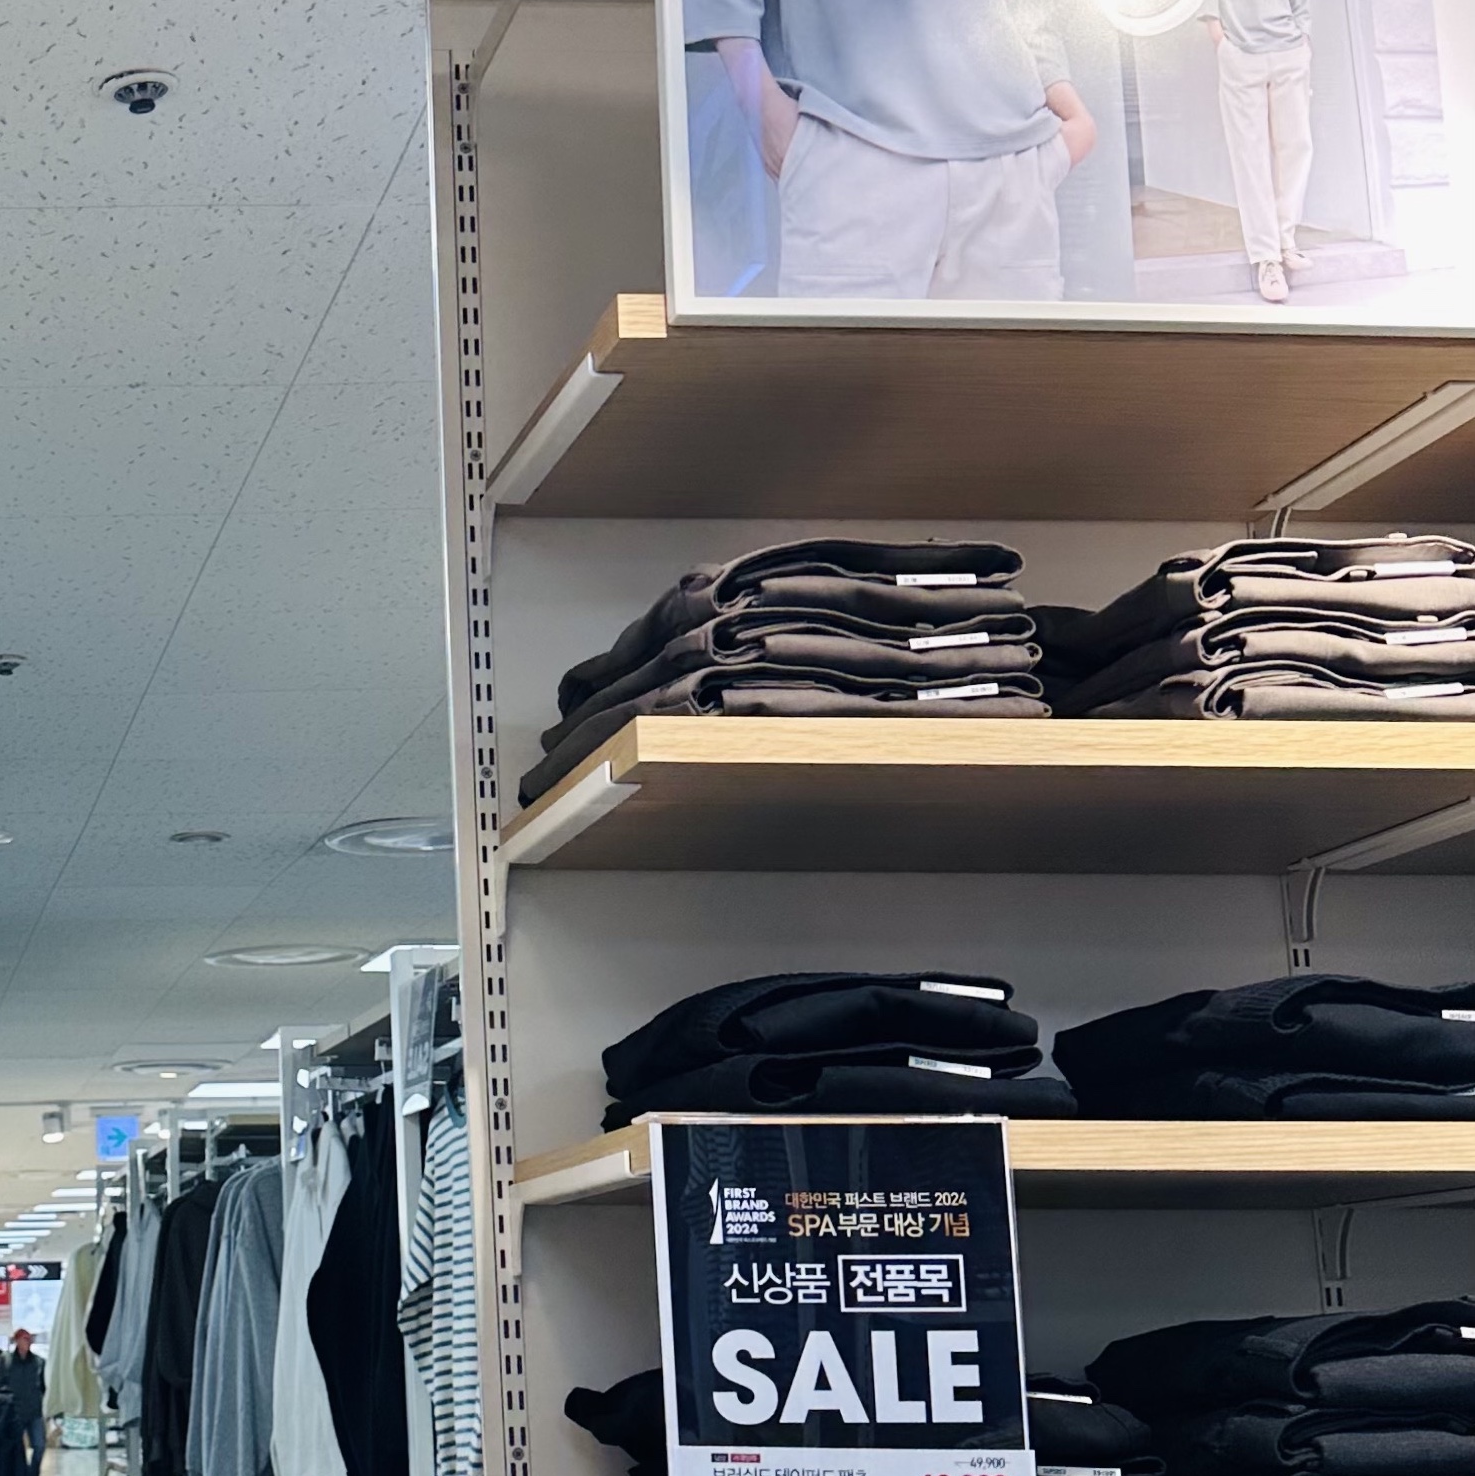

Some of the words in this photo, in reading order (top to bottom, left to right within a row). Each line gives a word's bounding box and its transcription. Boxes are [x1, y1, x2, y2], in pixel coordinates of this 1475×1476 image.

[723, 1187, 756, 1199] FIRST
[724, 1199, 770, 1211] BRAND
[785, 1191, 841, 1209] 대한민국
[844, 1191, 887, 1208] 퍼스트
[889, 1191, 933, 1208] 브랜드
[934, 1191, 968, 1207] 2024
[725, 1211, 777, 1223] AWARDS
[726, 1222, 759, 1235] 2024
[884, 1211, 925, 1238] 대상
[929, 1212, 971, 1238] 기념
[723, 1261, 831, 1305] 신상품
[849, 1263, 953, 1304] 전품목
[711, 1328, 984, 1426] SALE
[970, 1457, 1006, 1470] 49,900
